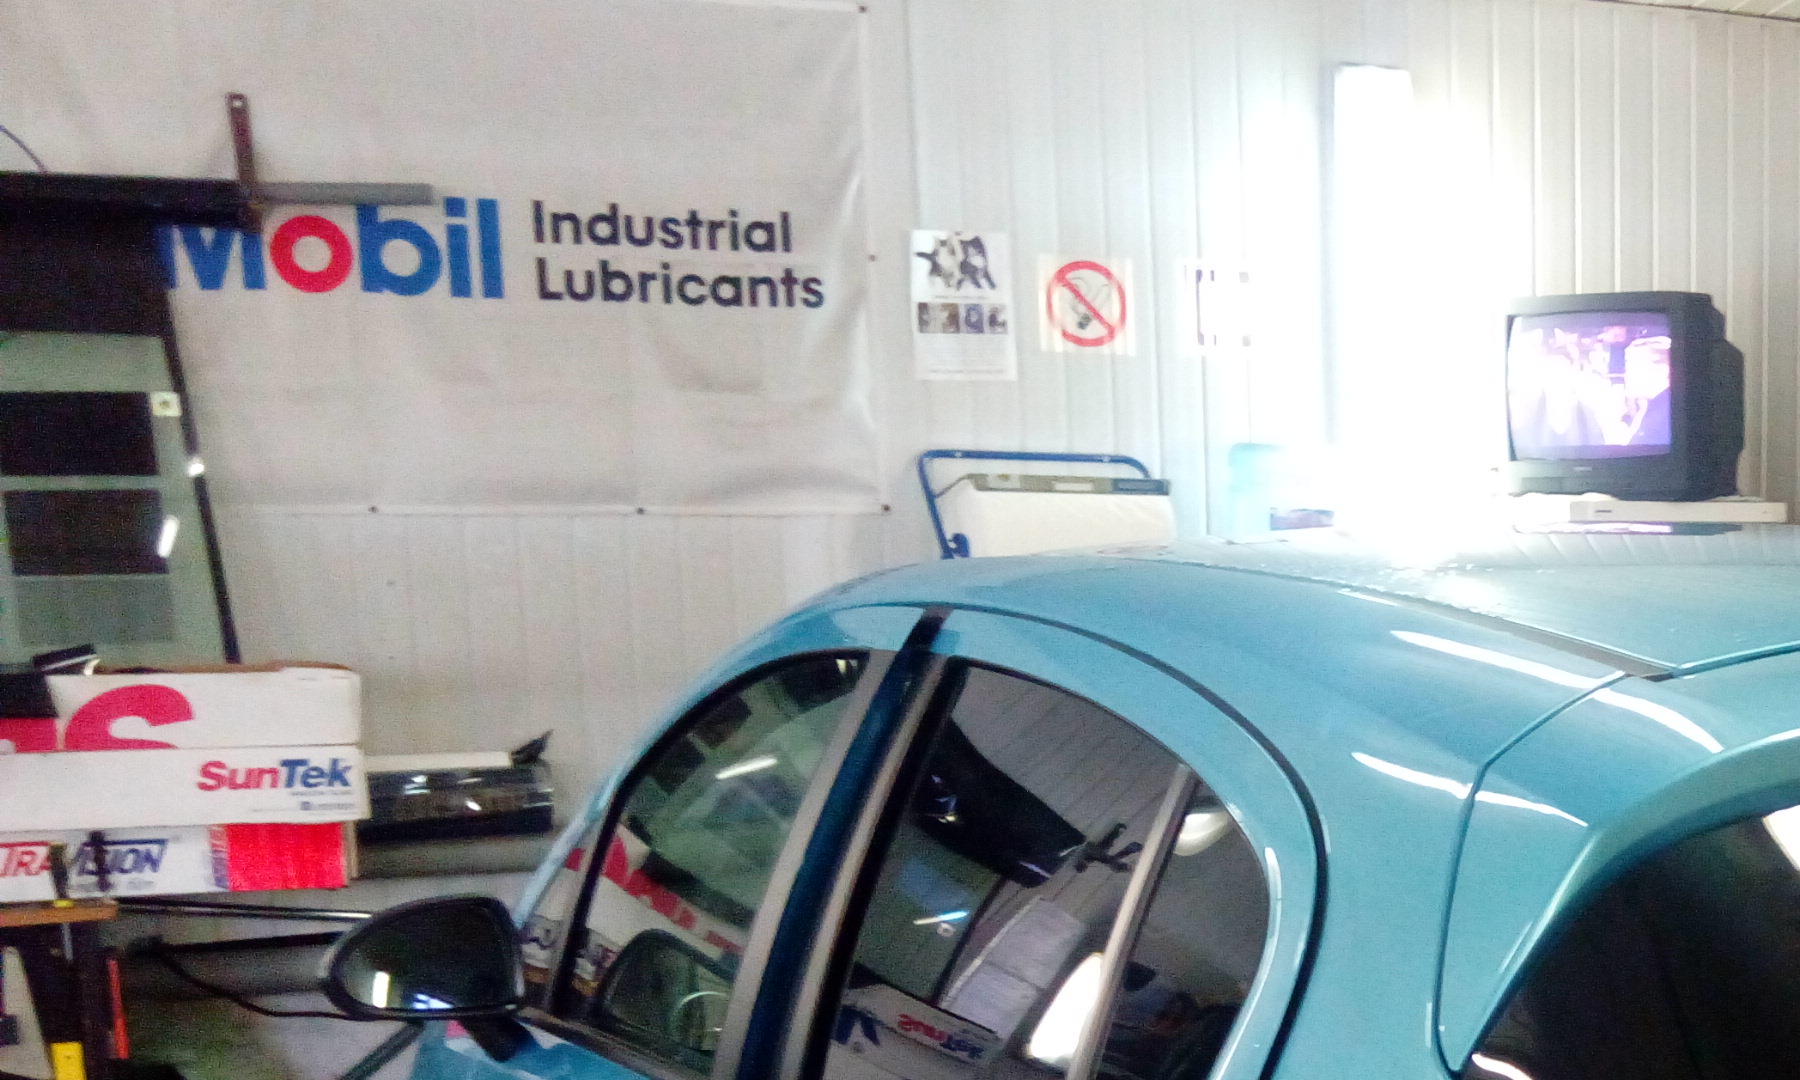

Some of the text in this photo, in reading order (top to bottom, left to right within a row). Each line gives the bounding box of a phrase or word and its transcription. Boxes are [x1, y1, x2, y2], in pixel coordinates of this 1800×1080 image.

[155, 196, 505, 298] Mobil
[532, 199, 793, 252] Industrial
[535, 256, 826, 309] Lubricants
[196, 758, 352, 791] SunTek
